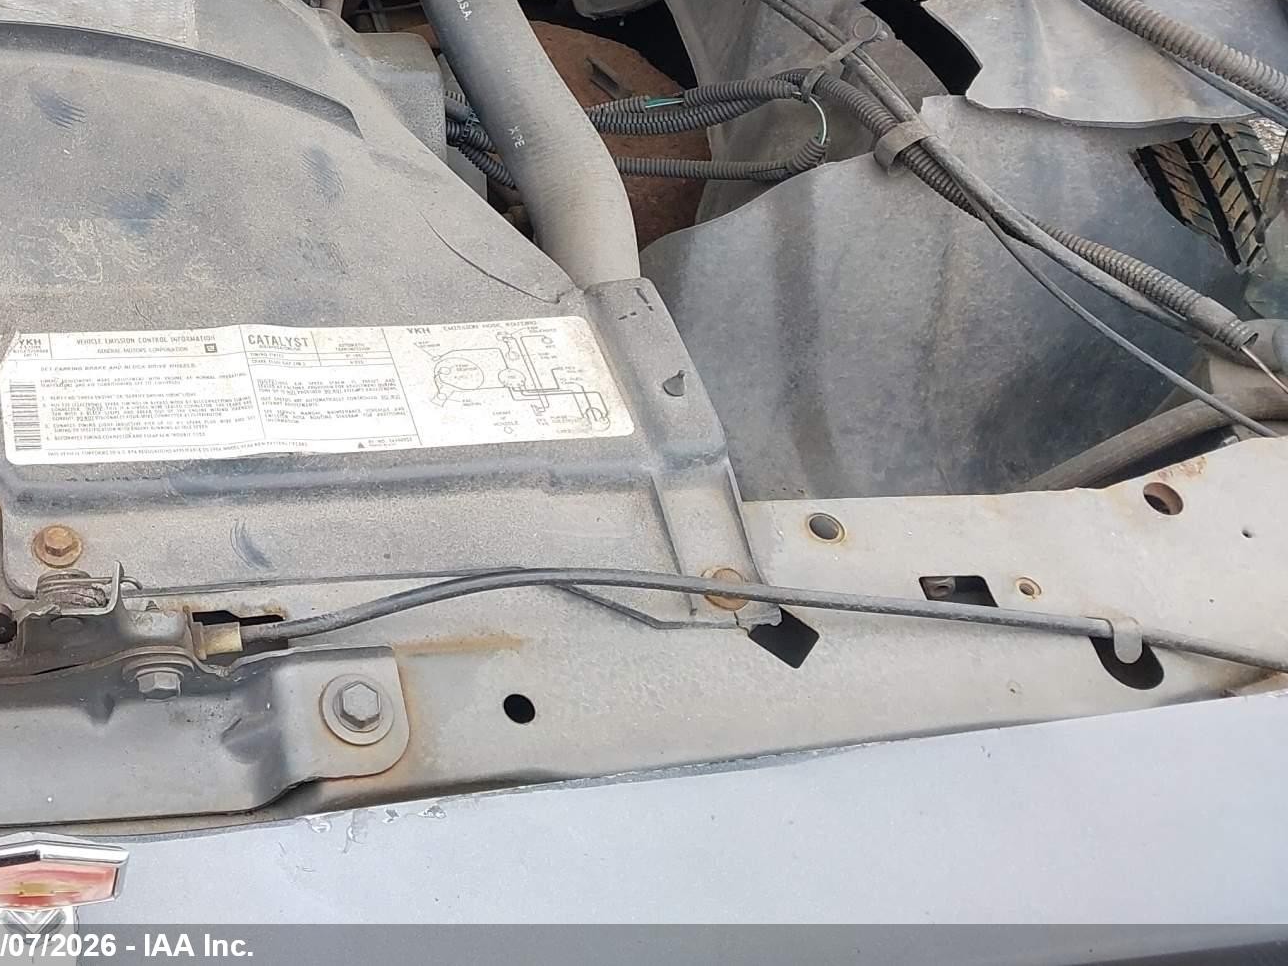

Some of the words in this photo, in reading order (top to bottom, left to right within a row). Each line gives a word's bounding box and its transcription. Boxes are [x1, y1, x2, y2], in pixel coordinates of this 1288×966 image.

[19, 338, 42, 346] YKH
[104, 337, 135, 345] EMISSION
[138, 336, 168, 344] CONTROL
[170, 335, 216, 343] INFORMATION
[247, 334, 309, 348] CATALYST
